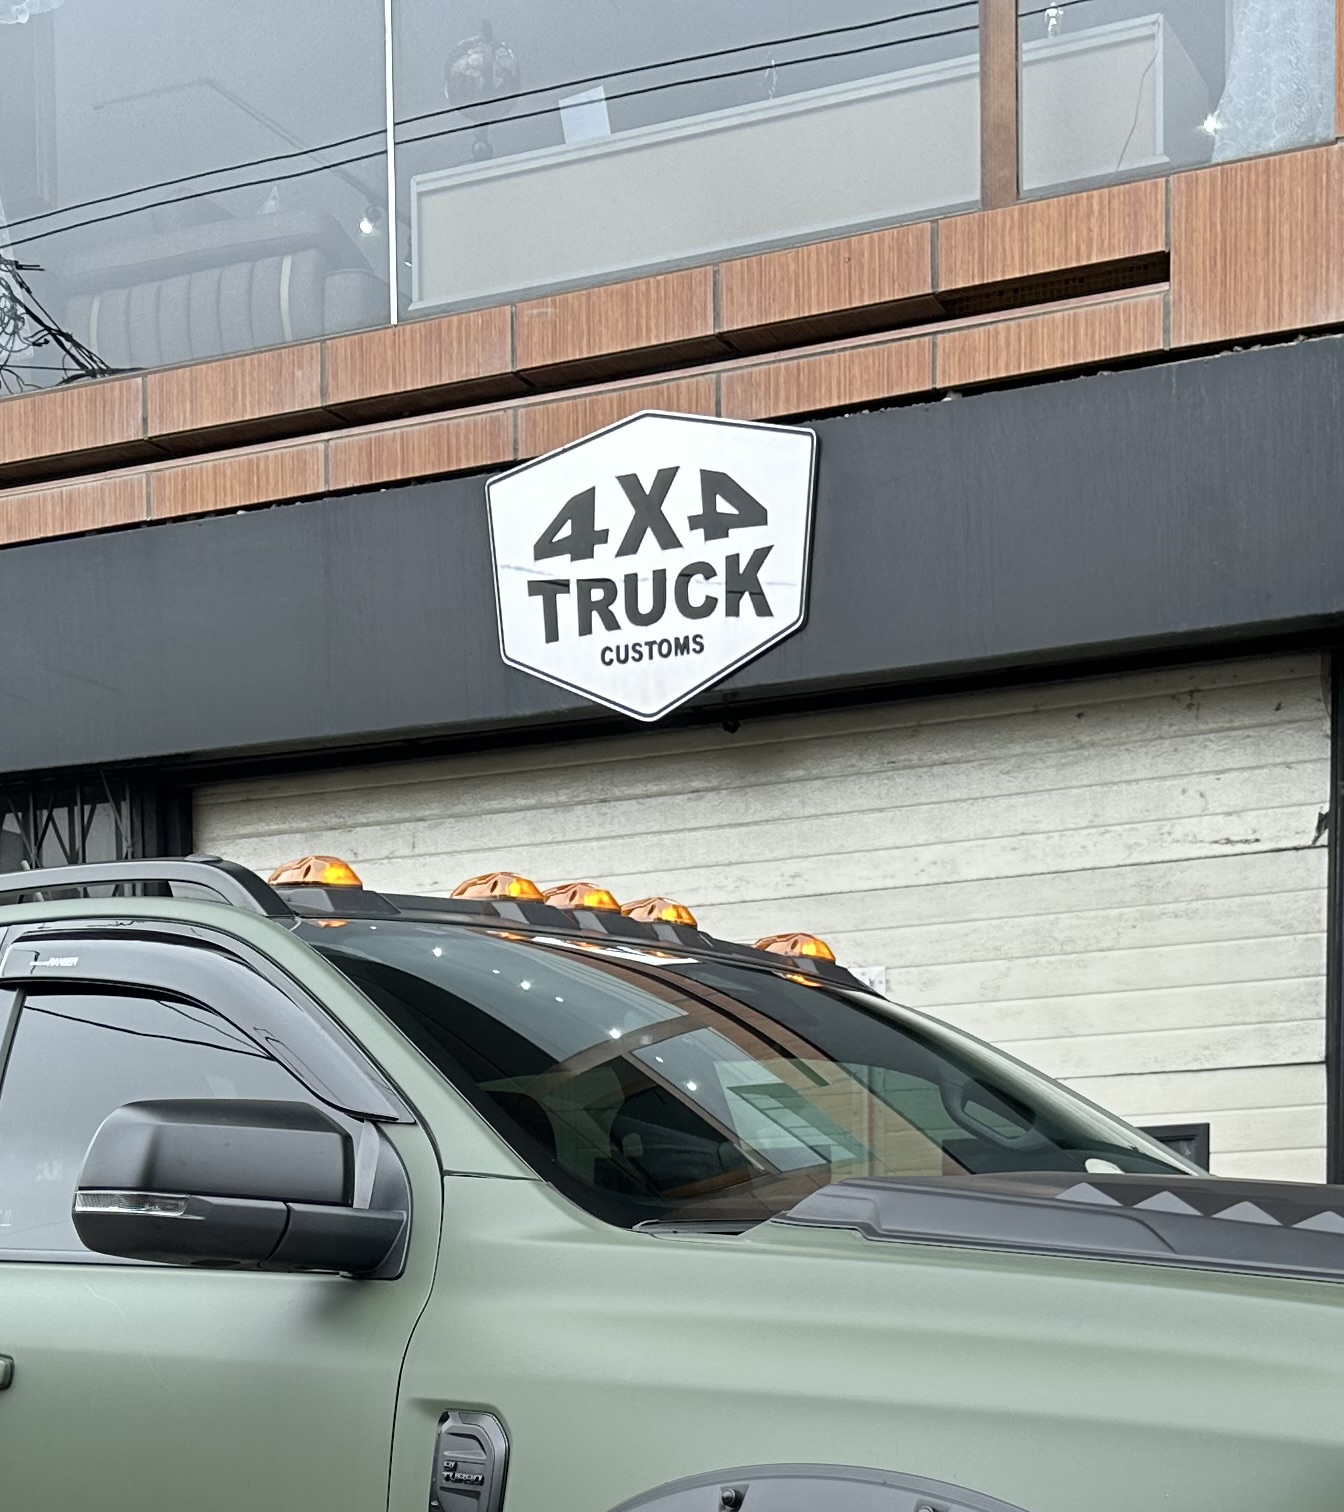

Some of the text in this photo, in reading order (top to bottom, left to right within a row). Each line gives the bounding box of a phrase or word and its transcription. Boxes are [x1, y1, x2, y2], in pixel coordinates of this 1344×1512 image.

[533, 465, 769, 563] 4X4
[527, 543, 775, 645] TRUCK
[600, 634, 706, 667] CUSTOMS
